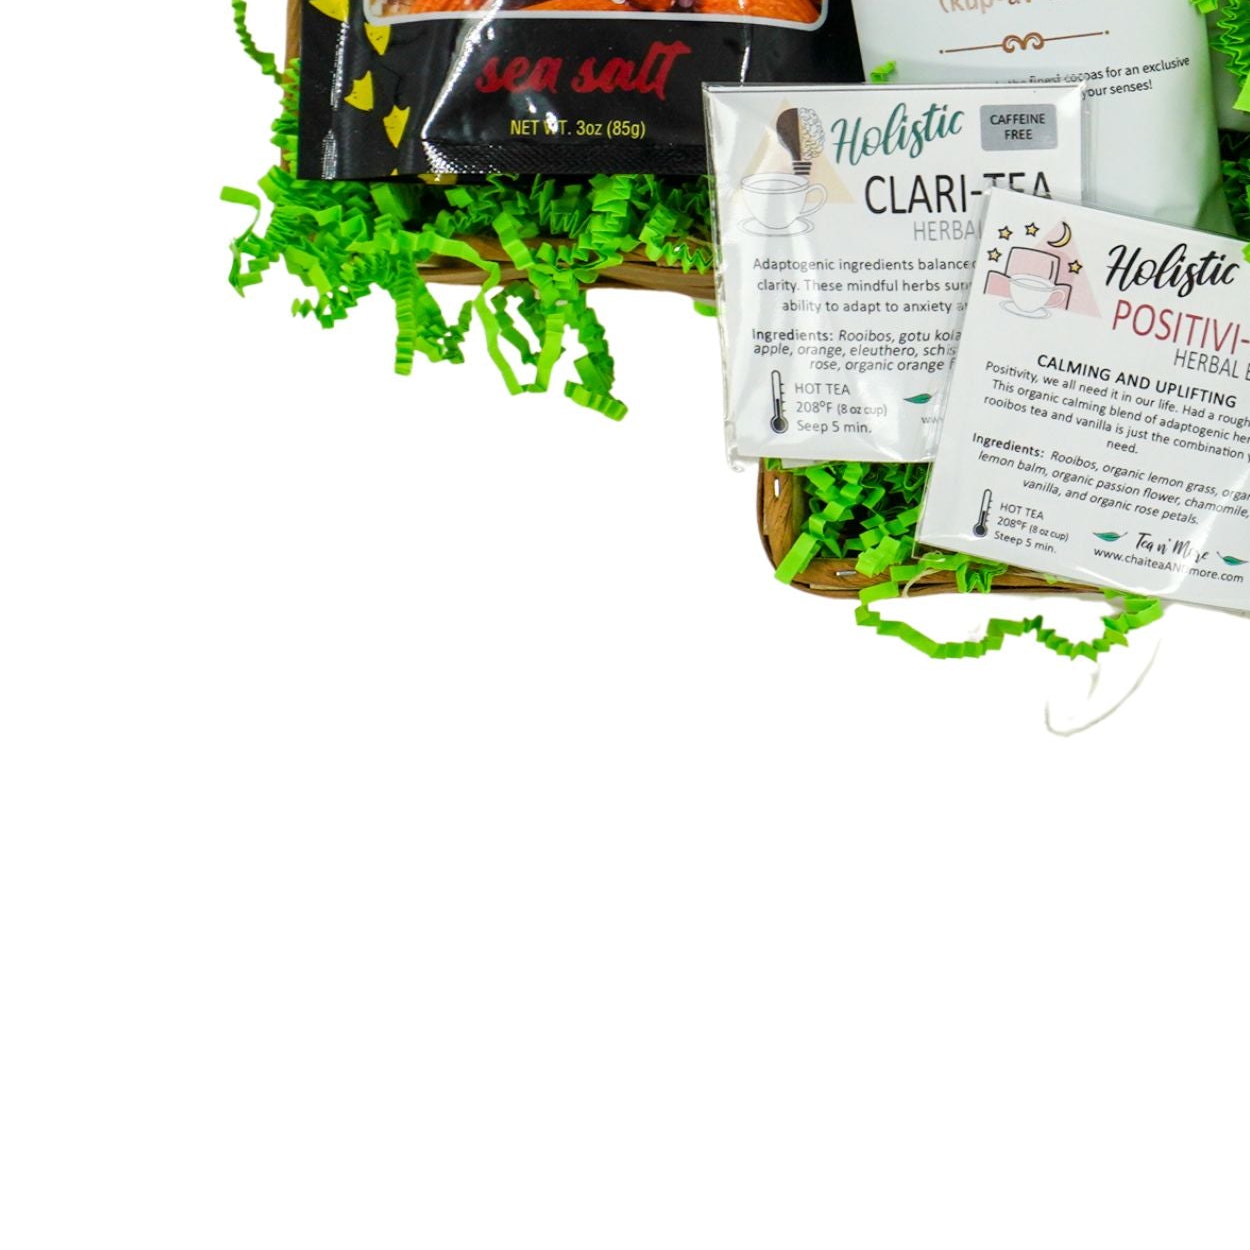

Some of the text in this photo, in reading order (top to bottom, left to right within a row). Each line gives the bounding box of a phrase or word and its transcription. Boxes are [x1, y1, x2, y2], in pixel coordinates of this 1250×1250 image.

[475, 40, 691, 100] sea salt
[1106, 56, 1190, 79] for an exclusive
[1082, 79, 1153, 100] your senses!
[989, 113, 1046, 125] CAFFEINE
[510, 120, 646, 138] NET WT. 3oz (85g)
[830, 102, 964, 167] Holistic
[1004, 128, 1033, 141] FREE
[752, 258, 914, 274] Adaptogenic ingredients
[1105, 243, 1240, 297] Holistic
[757, 279, 800, 293] clarity.
[804, 279, 843, 291] These
[847, 279, 898, 291] mindful
[902, 279, 940, 291] herbs
[782, 300, 821, 314] ability
[825, 301, 839, 312] to
[843, 300, 880, 315] adapt
[885, 301, 899, 312] to
[903, 300, 952, 314] anxiety
[752, 329, 930, 344] Ingredients: Rooibos, gotu
[753, 343, 918, 358] apple, orange, eleuthero,
[809, 359, 841, 372] rose,
[845, 359, 893, 374] organic
[897, 361, 945, 374] orange
[1173, 348, 1239, 379] HERBAL
[795, 383, 850, 395] HOT TEA
[1037, 354, 1237, 408] CALMING AND UPLIFTING
[985, 361, 1038, 383] Positivity,
[1043, 375, 1059, 387] we
[1062, 379, 1076, 391] all
[1079, 383, 1108, 397] need
[1111, 388, 1119, 400] it
[1122, 391, 1132, 403] in
[1135, 396, 1155, 408] our
[1158, 398, 1178, 414] life.
[1182, 405, 1206, 418] Had
[1207, 412, 1215, 420] a
[1218, 414, 1250, 429] rough
[837, 404, 887, 417] (8 oz cup)
[992, 378, 1014, 393] This
[1017, 387, 1059, 404] organic
[1062, 397, 1107, 416] calming
[1109, 405, 1142, 421] blend
[1144, 413, 1157, 425] of
[1159, 417, 1230, 440] adaptogenic
[797, 420, 872, 434] Seep 5 min.
[984, 395, 1027, 413] rooibos
[1030, 406, 1048, 418] tea
[1050, 411, 1073, 423] and
[1076, 416, 1112, 432] vanilla
[1115, 424, 1124, 435] is
[1126, 426, 1148, 440] just
[1151, 432, 1170, 445] the
[1173, 437, 1244, 460] combination
[1106, 440, 1139, 455] need.
[972, 432, 1045, 458] Ingredients:
[1050, 450, 1099, 472] Rooibos,
[1102, 464, 1145, 481] organic
[1147, 471, 1184, 489] lemon
[1185, 481, 1218, 497] grass,
[978, 450, 1250, 519] lemon balm, organic passion flower, chamomile,
[1000, 502, 1044, 520] HOT TEA
[1023, 479, 1199, 526] vanilla, and organic rose petals.
[994, 530, 1056, 554] Steep 5 min.
[1050, 530, 1069, 542] cup)
[1135, 532, 1153, 550] Tea
